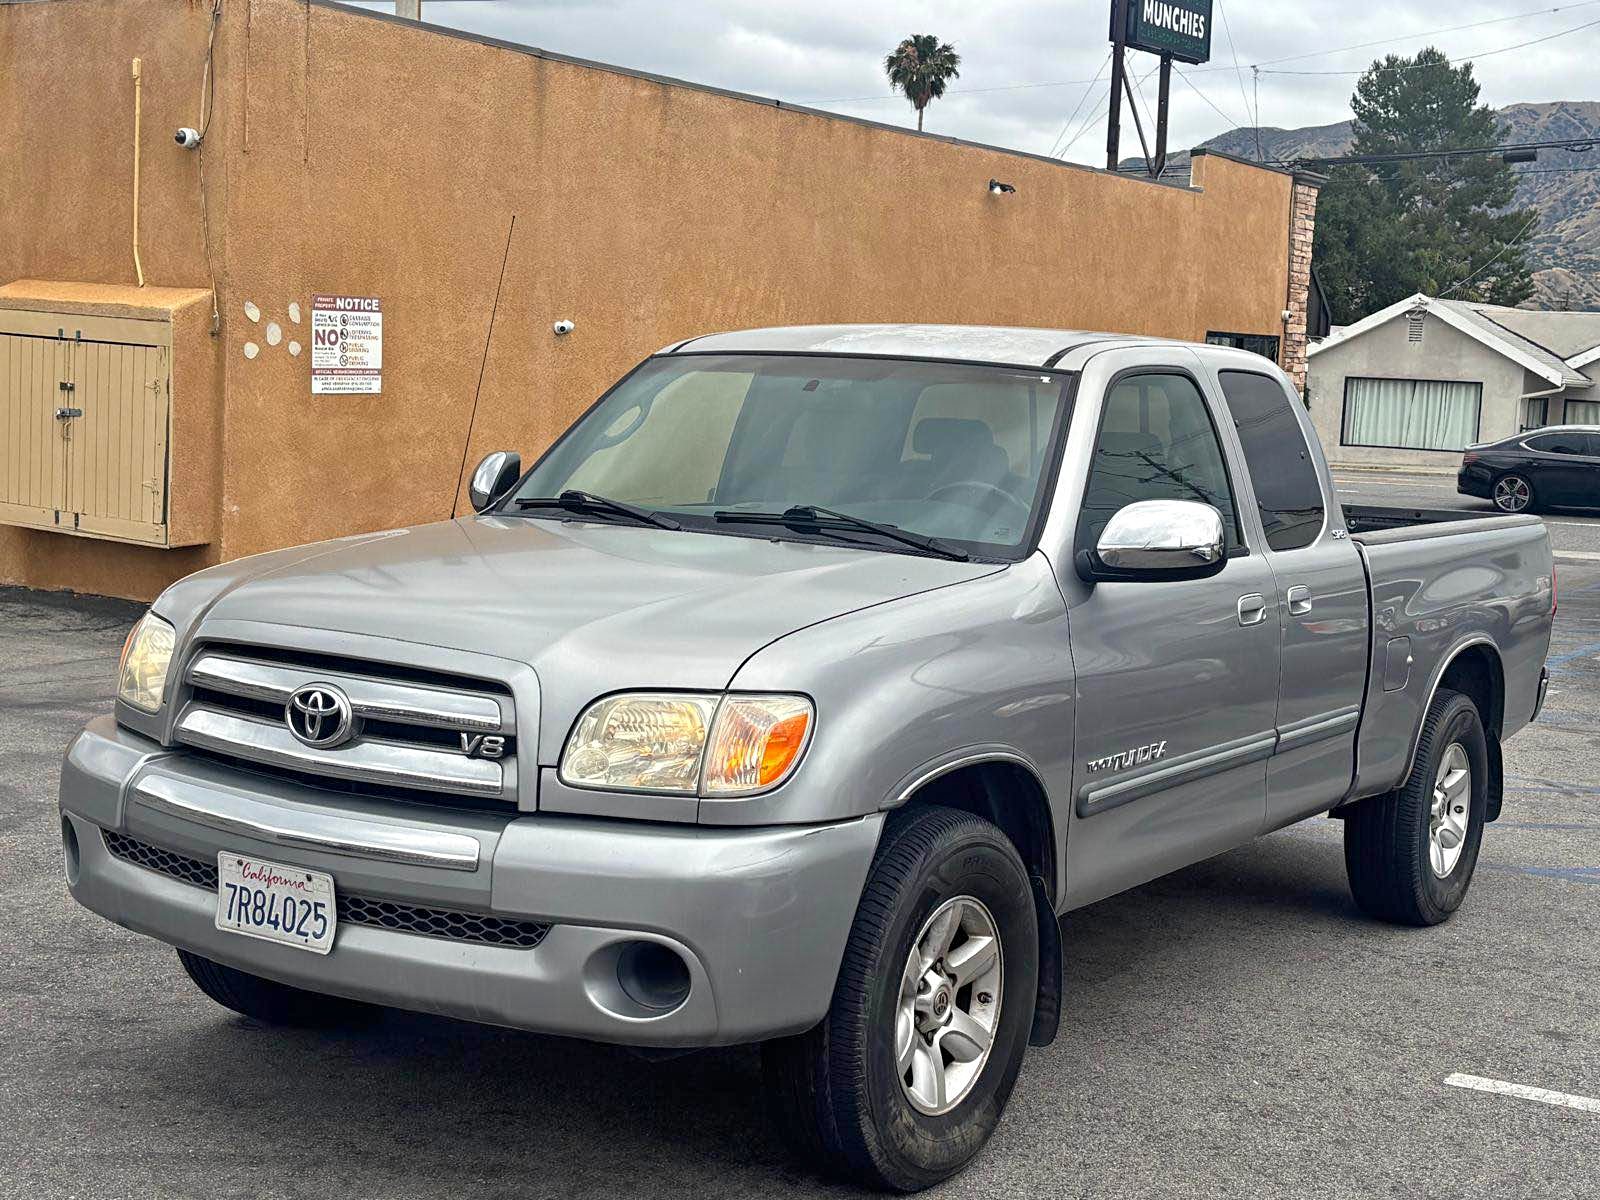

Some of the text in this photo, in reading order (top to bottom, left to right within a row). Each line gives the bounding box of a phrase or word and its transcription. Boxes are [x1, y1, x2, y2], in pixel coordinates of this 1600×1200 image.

[1143, 0, 1205, 39] MUNCHIES
[336, 298, 379, 310] NOTICE
[315, 329, 339, 346] NO
[460, 732, 505, 758] V8
[1112, 740, 1167, 771] TUNDRA
[242, 862, 313, 892] California
[225, 882, 328, 940] 7R84025
